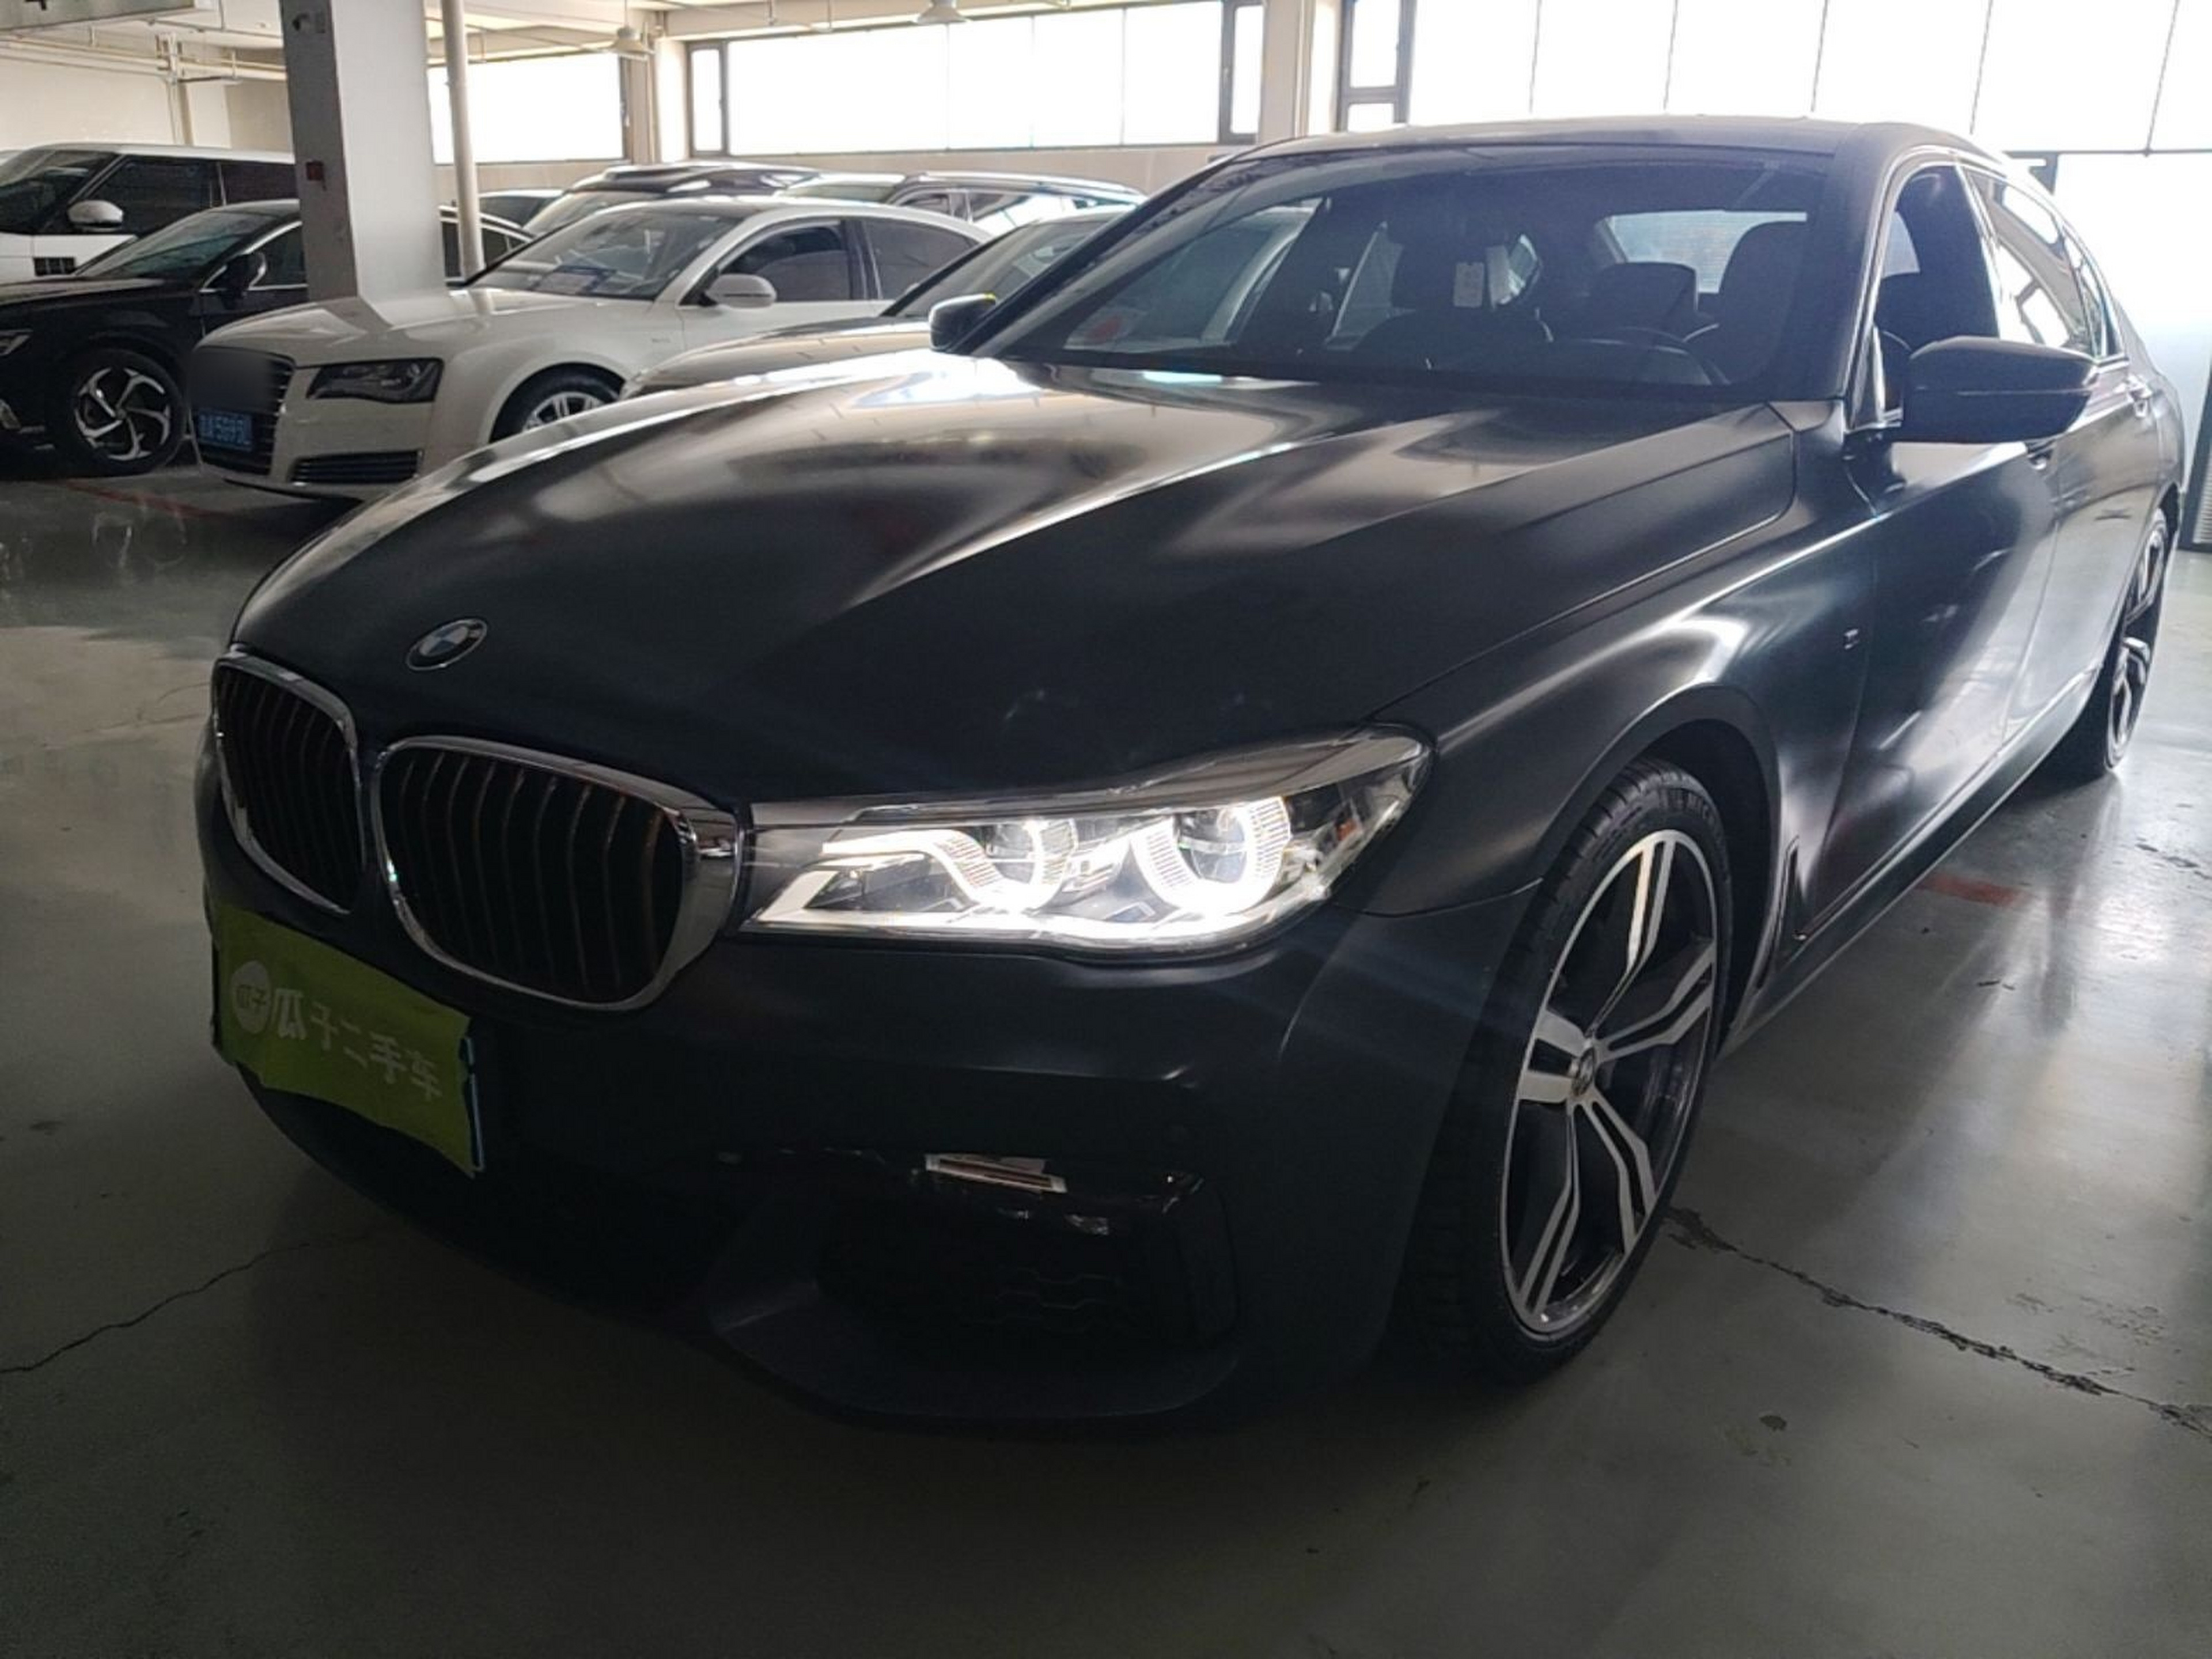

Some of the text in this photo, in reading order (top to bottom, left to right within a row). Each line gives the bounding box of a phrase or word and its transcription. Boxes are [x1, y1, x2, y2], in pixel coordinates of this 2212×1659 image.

[271, 987, 444, 1101] 瓜子二手车
